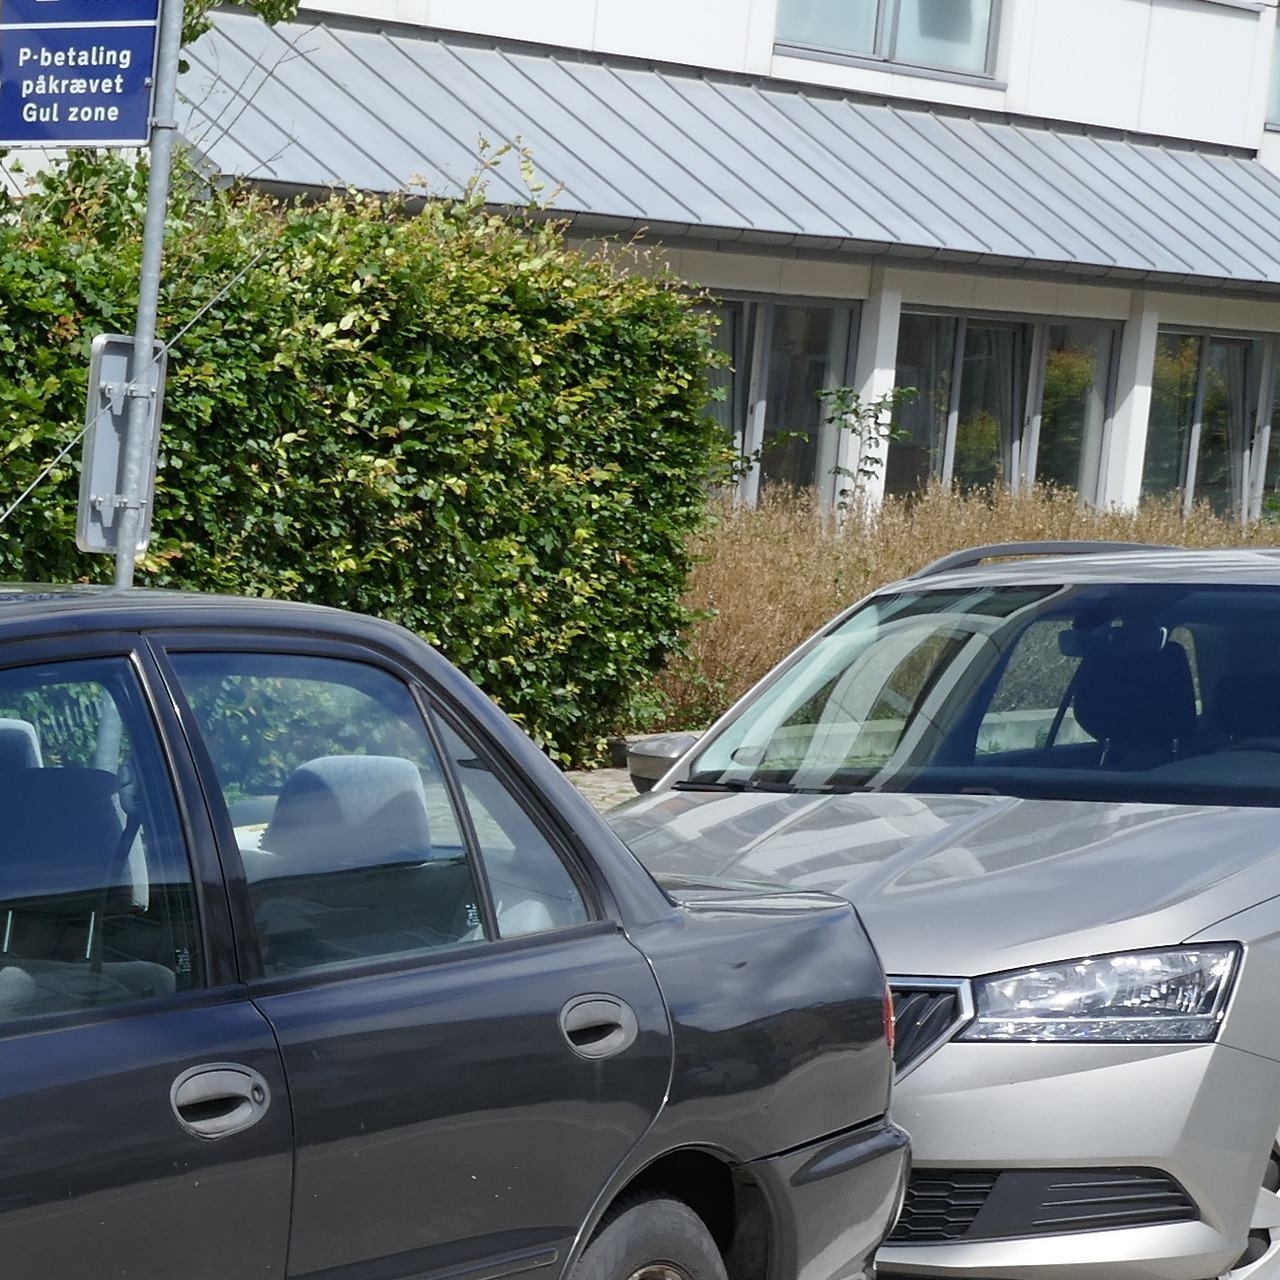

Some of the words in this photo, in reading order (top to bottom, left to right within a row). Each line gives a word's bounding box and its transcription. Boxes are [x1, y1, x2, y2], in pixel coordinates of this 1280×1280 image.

[19, 46, 131, 69] P-betaling
[21, 74, 125, 98] påkrævet
[22, 103, 60, 122] Gul
[68, 105, 120, 121] zone
